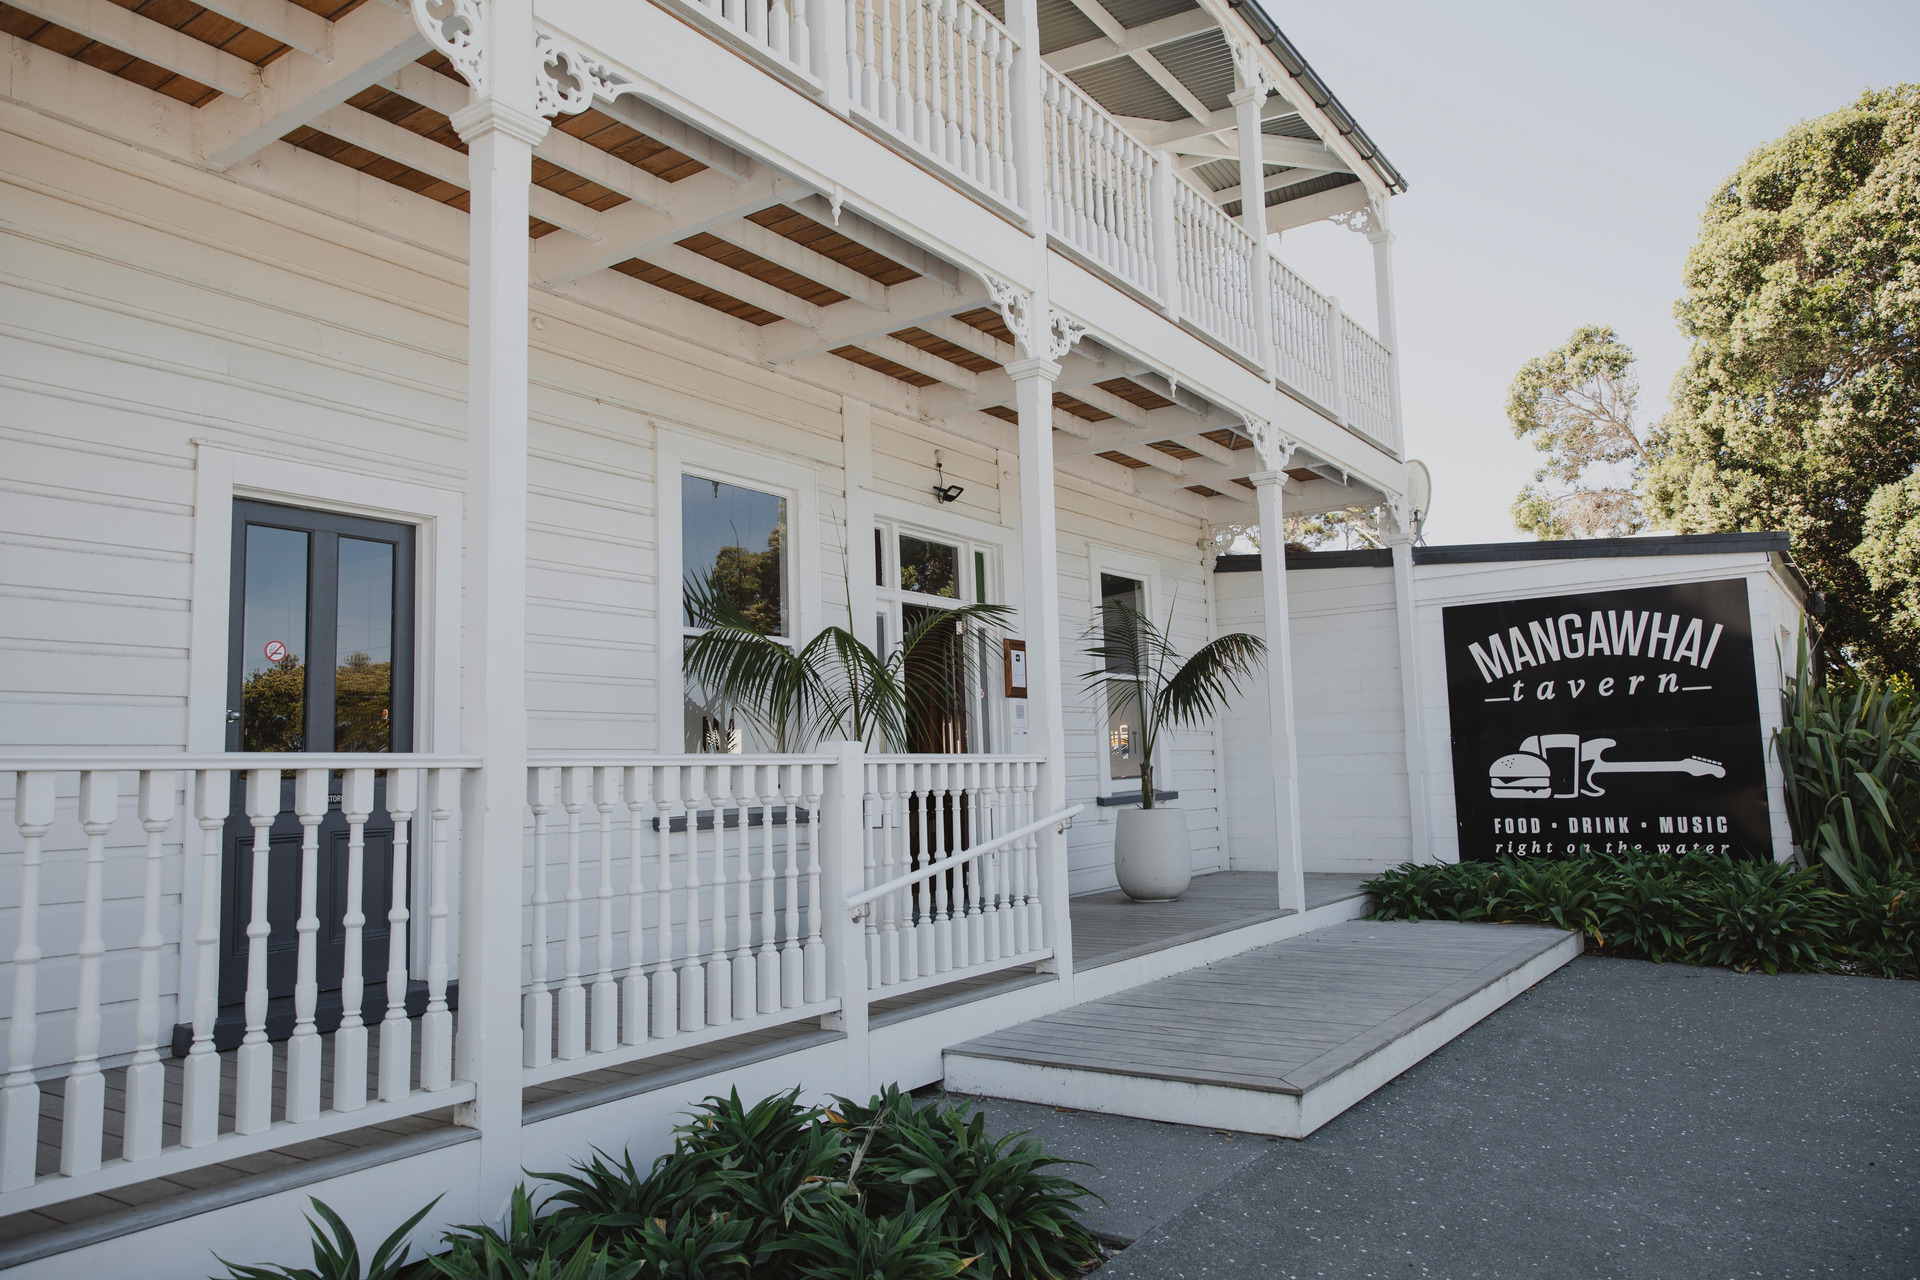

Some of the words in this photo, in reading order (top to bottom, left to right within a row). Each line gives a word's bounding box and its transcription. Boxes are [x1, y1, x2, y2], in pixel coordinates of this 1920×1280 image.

[1468, 610, 1723, 684] MANGAWHAI
[1513, 672, 1680, 702] tavern
[1494, 817, 1541, 834] FOOD
[1568, 817, 1630, 834] DRINK
[1659, 816, 1728, 834] MUSIC
[1495, 840, 1553, 857] right
[1605, 840, 1642, 854] the
[1657, 842, 1730, 855] water
